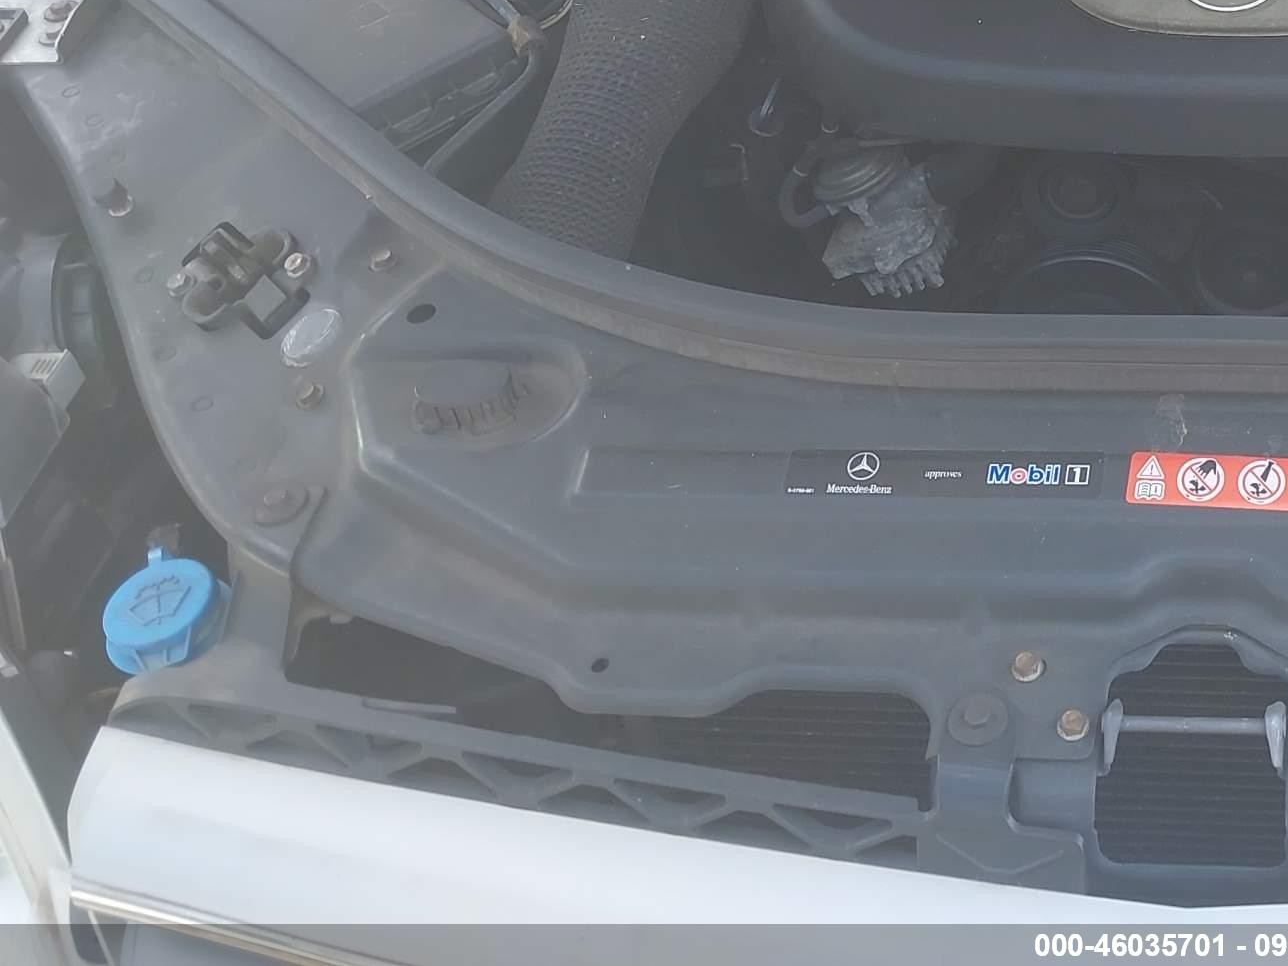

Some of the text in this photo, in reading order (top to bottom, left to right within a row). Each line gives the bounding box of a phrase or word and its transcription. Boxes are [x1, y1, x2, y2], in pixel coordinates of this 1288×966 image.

[924, 469, 962, 479] approves
[986, 463, 1062, 484] Mobil
[826, 483, 892, 494] Mercedes-Benz
